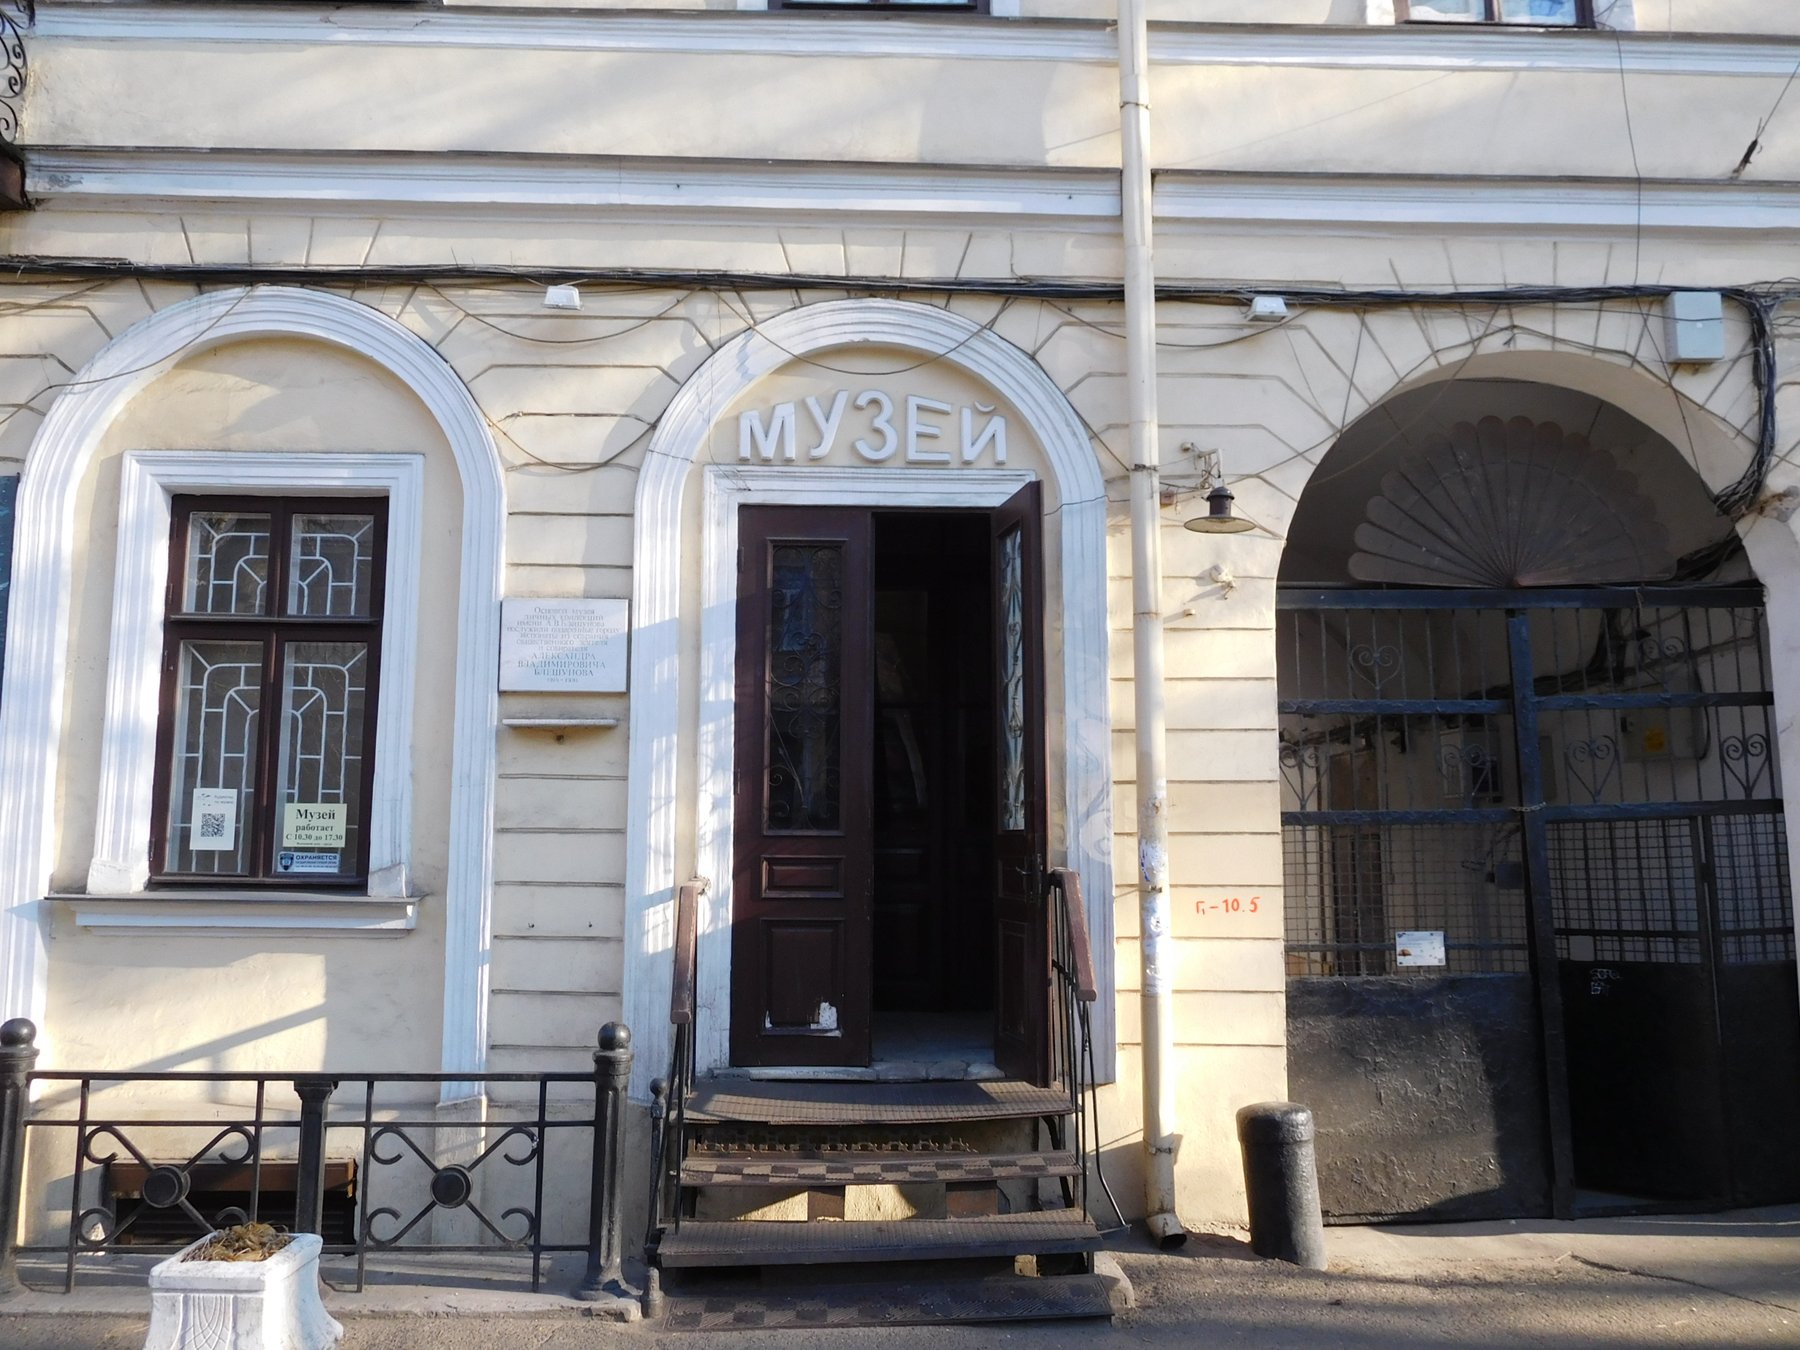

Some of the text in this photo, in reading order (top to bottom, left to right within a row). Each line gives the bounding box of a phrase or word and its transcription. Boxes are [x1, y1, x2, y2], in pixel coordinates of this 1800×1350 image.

[737, 389, 1008, 465] МУЗЕЙ
[296, 808, 336, 822] Музей
[295, 823, 334, 833] работает
